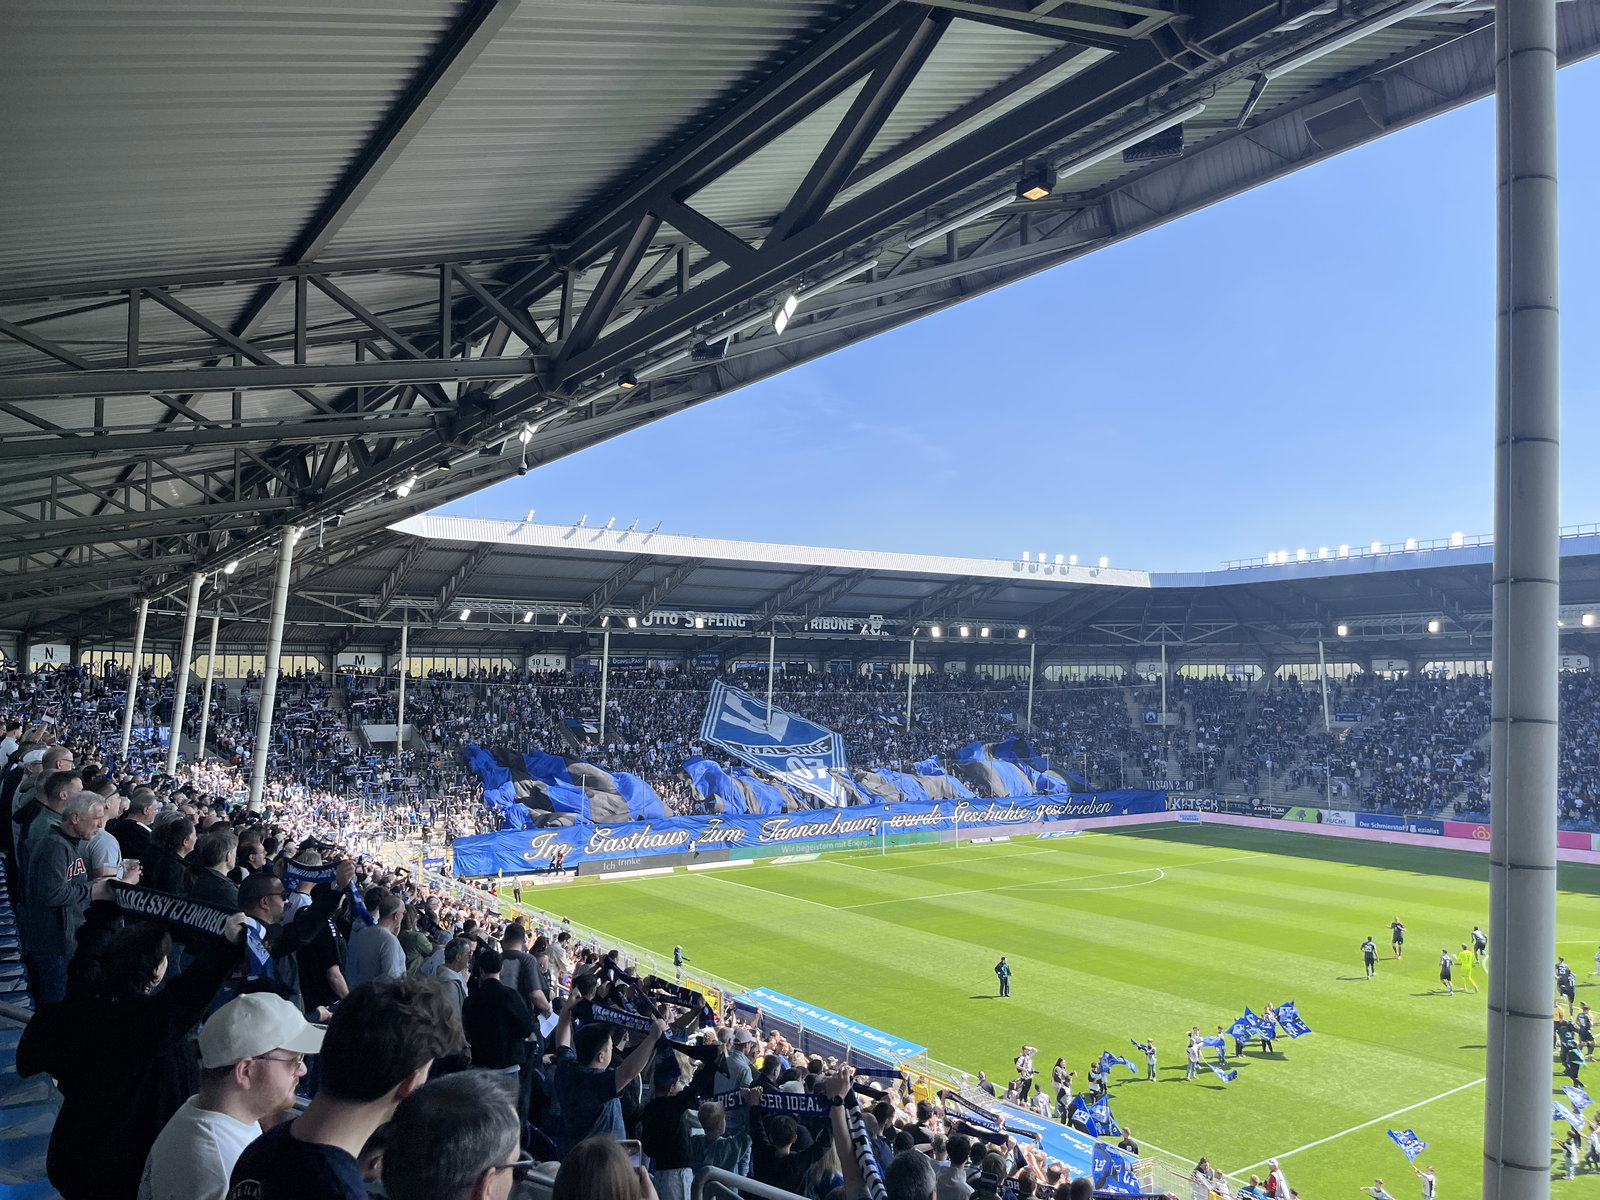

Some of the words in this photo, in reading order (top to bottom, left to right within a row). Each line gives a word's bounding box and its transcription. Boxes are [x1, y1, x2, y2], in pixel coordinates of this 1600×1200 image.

[685, 610, 746, 628] SFFLING
[45, 647, 54, 660] N
[355, 655, 366, 666] M
[532, 658, 541, 666] 10
[543, 657, 550, 666] L
[556, 658, 561, 666] 9
[1148, 663, 1156, 671] G
[1387, 661, 1394, 670] F
[1562, 657, 1570, 667] E
[786, 756, 827, 779] 07
[1146, 780, 1174, 791] VISION
[1175, 780, 1194, 791] 210
[524, 832, 573, 860] Im
[584, 824, 690, 854] Gasthaus
[699, 818, 746, 843] Zum
[889, 804, 942, 828] wurde
[951, 800, 1030, 823] Geschichte
[1033, 796, 1113, 823] geschrieben
[603, 862, 616, 871] Ich
[618, 857, 641, 866] trinke
[146, 894, 188, 921] CLASS
[785, 1095, 823, 1113] IDEAL
